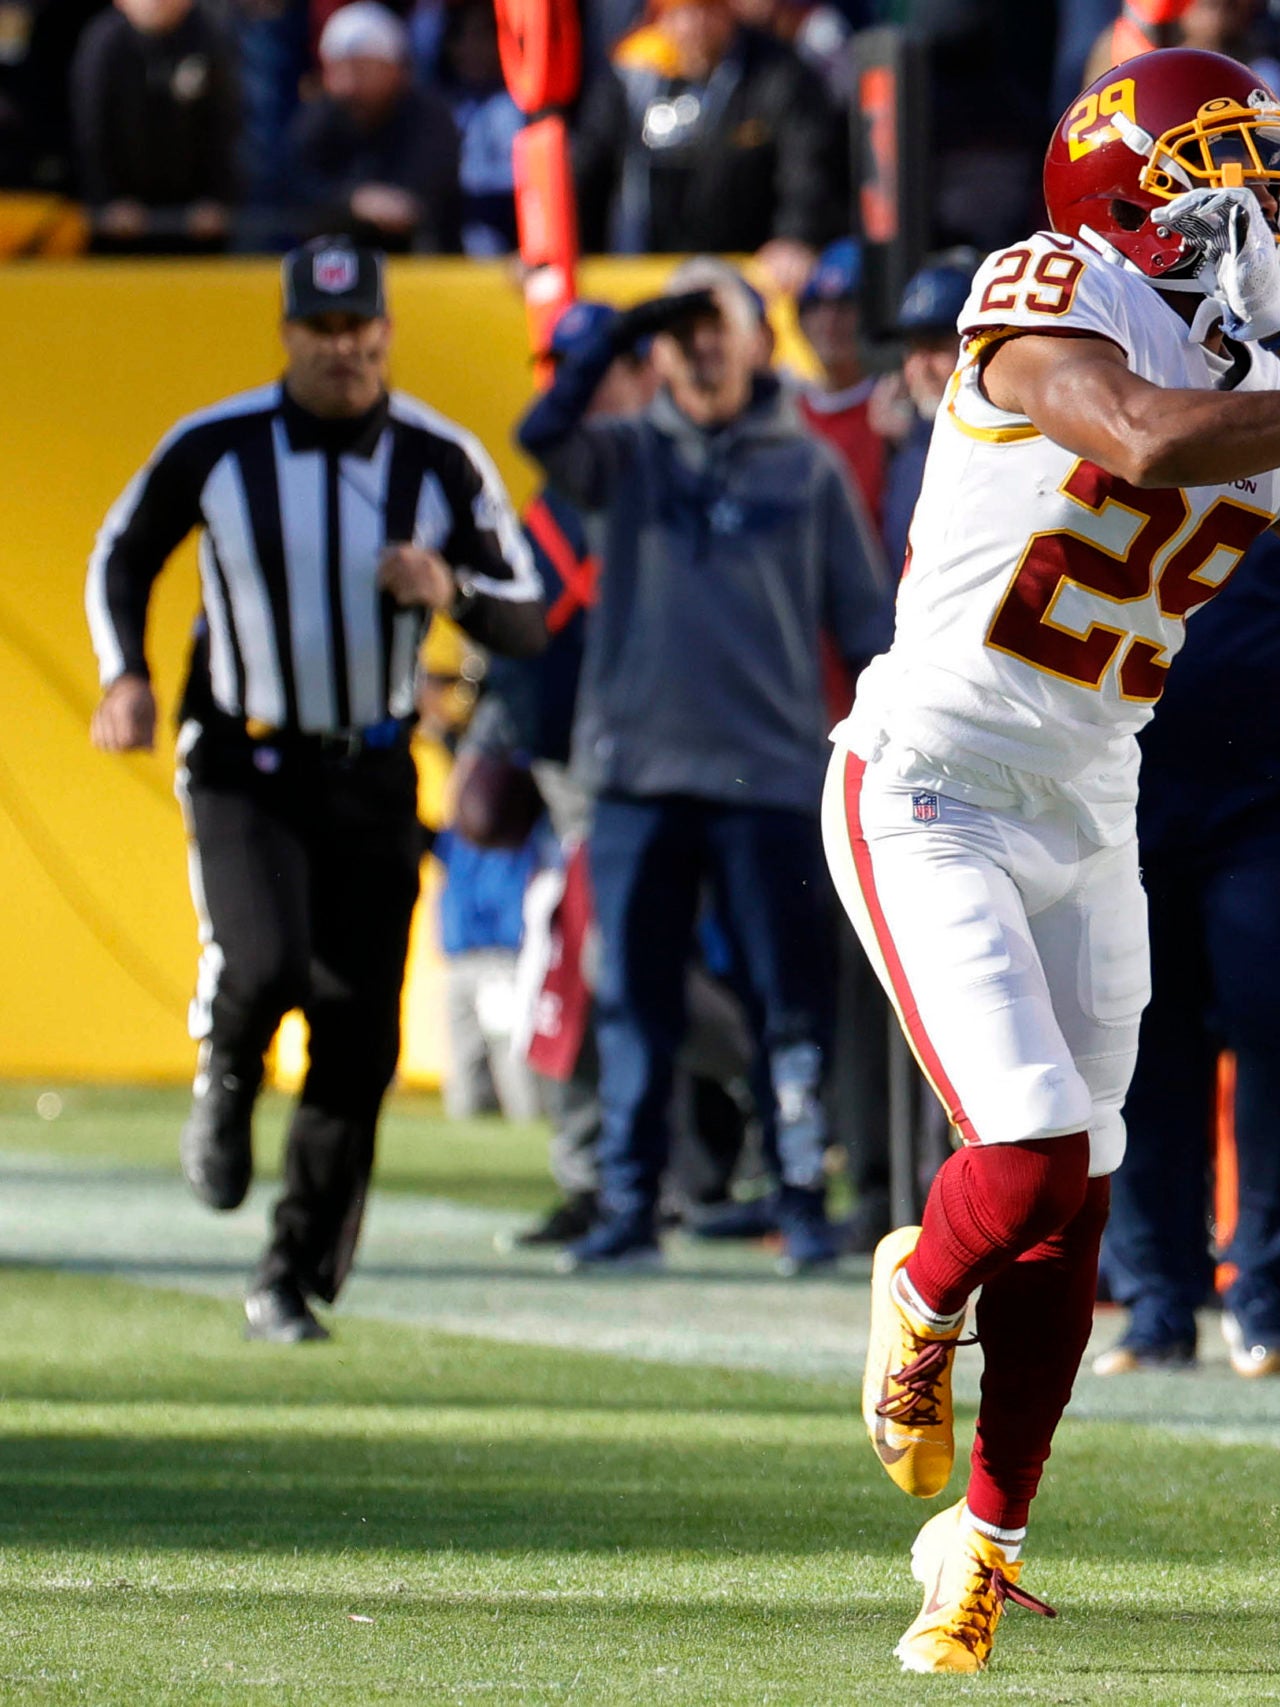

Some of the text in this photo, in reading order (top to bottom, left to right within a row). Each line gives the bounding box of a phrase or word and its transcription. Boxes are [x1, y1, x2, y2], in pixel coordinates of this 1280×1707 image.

[1067, 77, 1137, 163] 29
[979, 247, 1089, 318] 29
[983, 456, 1278, 703] 29
